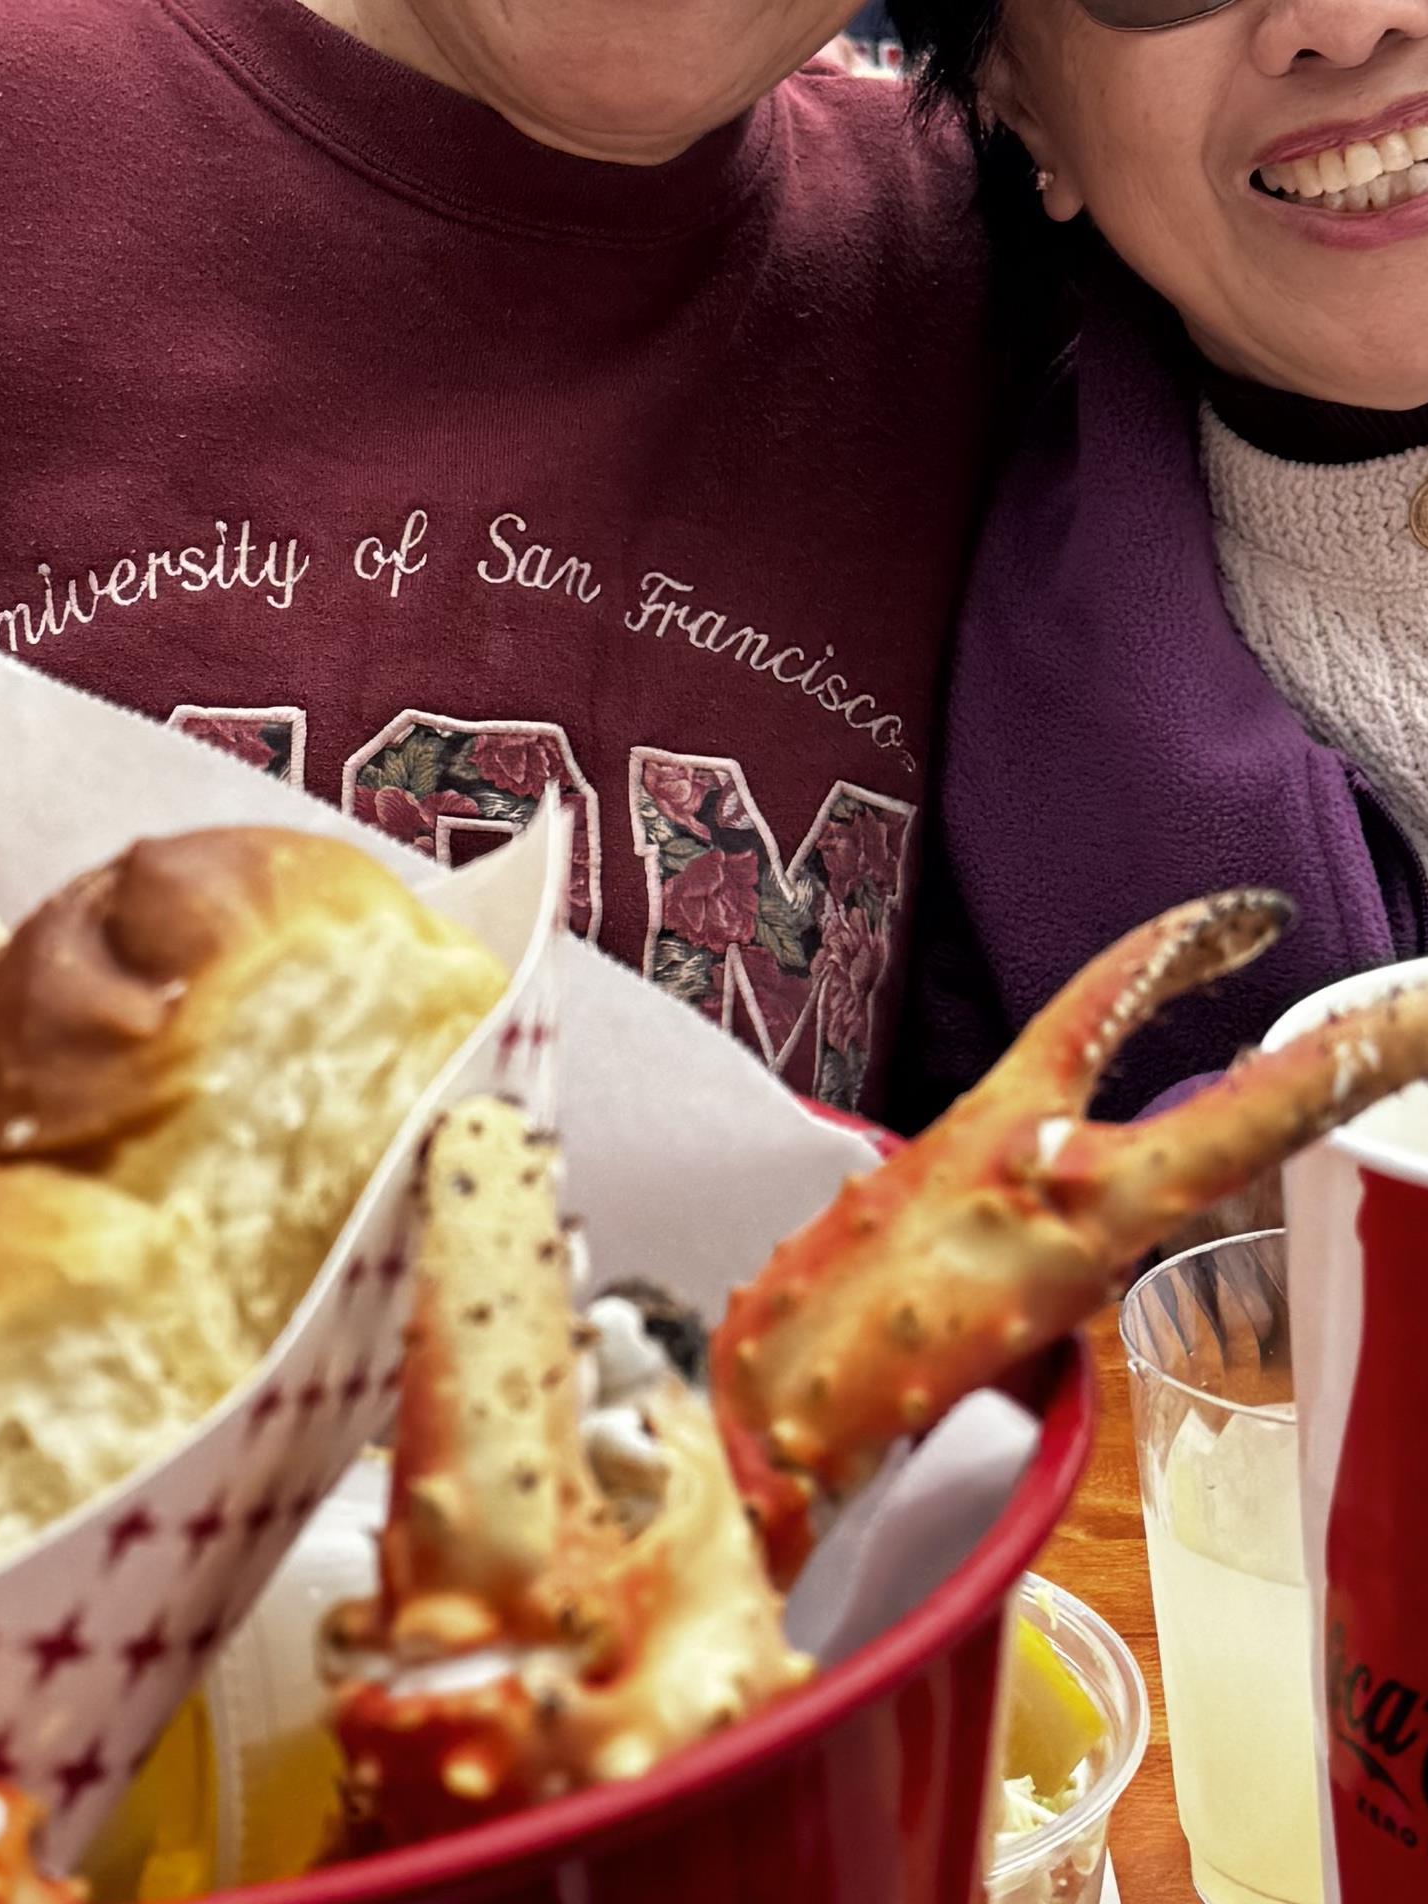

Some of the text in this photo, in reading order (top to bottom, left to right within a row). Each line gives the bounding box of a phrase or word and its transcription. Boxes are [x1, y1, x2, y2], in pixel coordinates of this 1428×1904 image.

[353, 508, 429, 598] of
[476, 511, 602, 604] San
[624, 571, 917, 768] Francisco
[1356, 1795, 1418, 1850] ZERO
